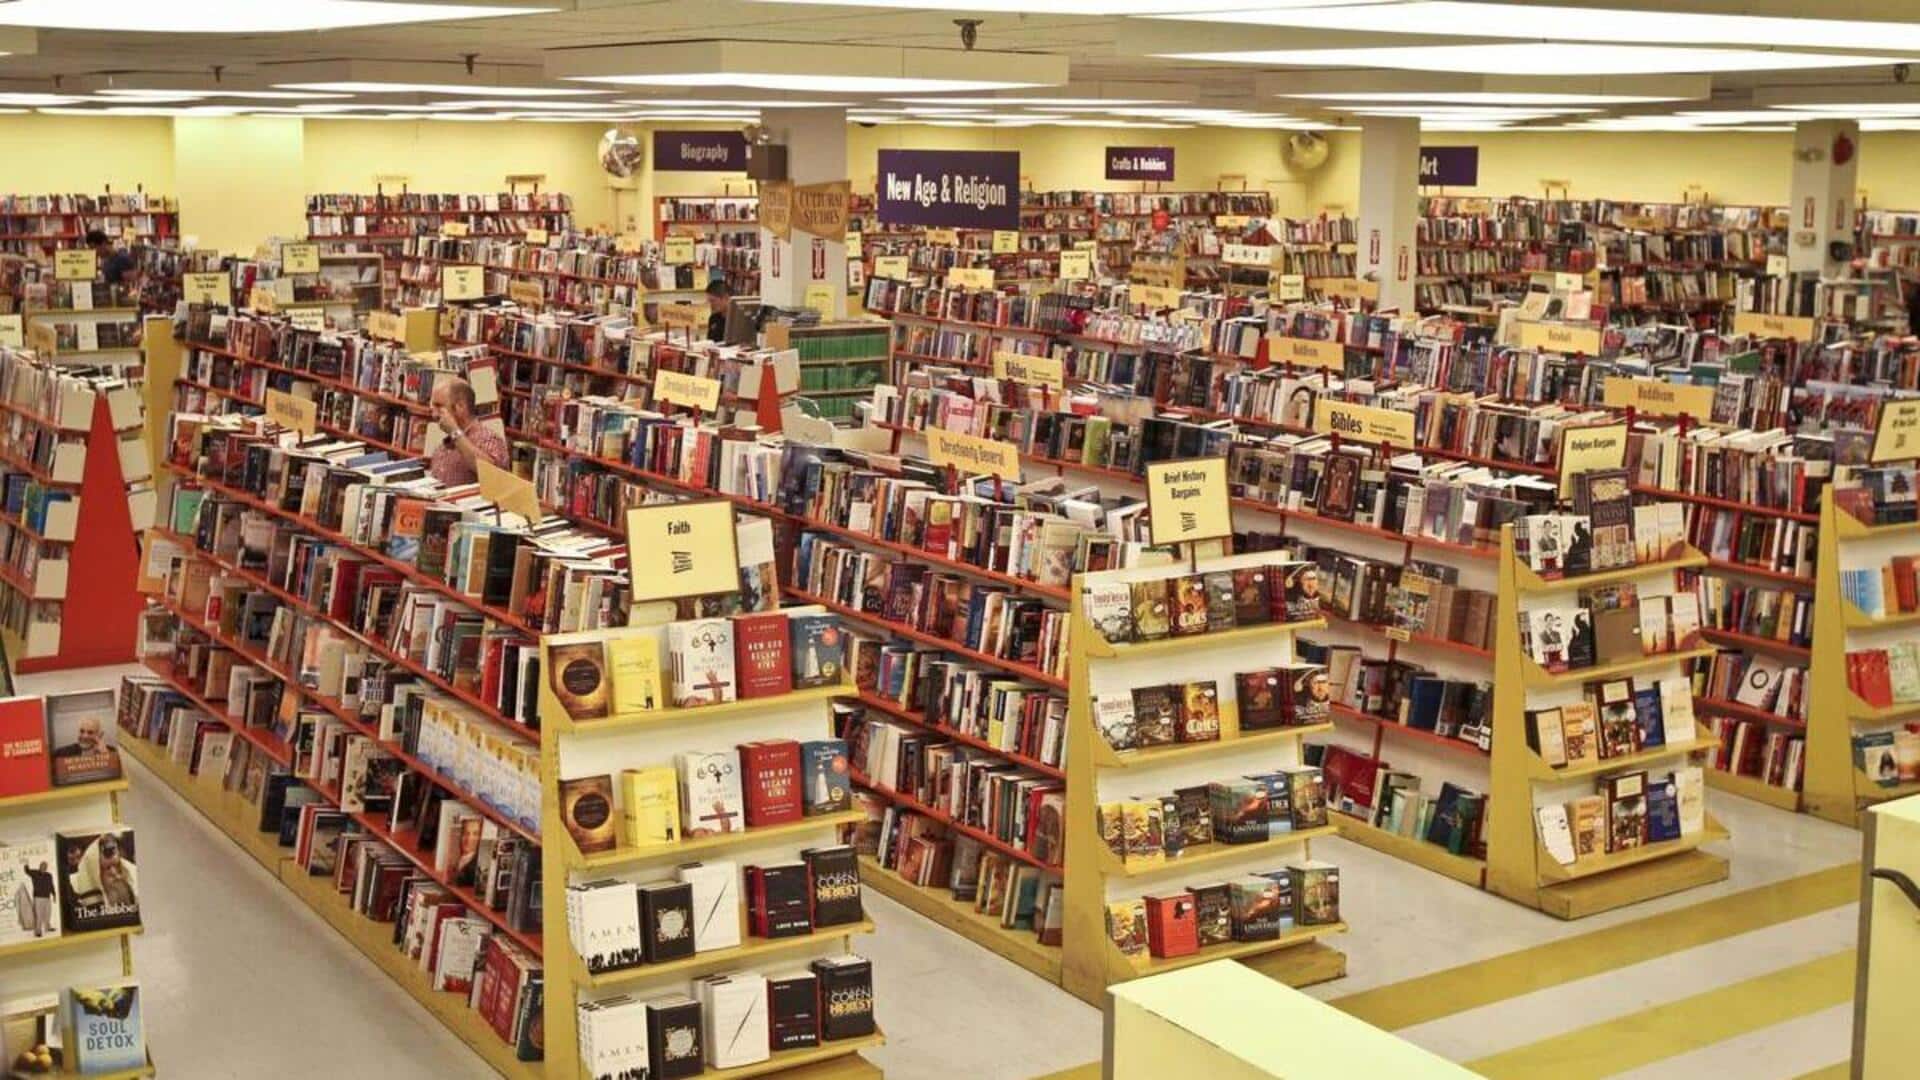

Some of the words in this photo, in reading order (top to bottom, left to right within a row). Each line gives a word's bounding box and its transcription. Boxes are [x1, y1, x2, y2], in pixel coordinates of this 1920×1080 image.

[681, 143, 728, 162] Biography
[1133, 157, 1138, 170] &
[1140, 157, 1166, 170] Hobbies
[1420, 156, 1438, 175] Art
[887, 173, 911, 200] New
[914, 174, 937, 207] Age
[941, 174, 950, 202] &
[955, 175, 1006, 210] Religion
[1006, 360, 1027, 378] Bibles
[1331, 411, 1362, 433] Bibles
[1164, 472, 1181, 484] Brief
[1182, 470, 1206, 482] History
[1171, 487, 1200, 499] Bargains
[668, 520, 690, 535] Faith
[75, 906, 97, 919] The
[590, 925, 635, 938] AMEN
[89, 1022, 127, 1036] SOUL
[87, 1035, 134, 1050] DETOX
[600, 1045, 645, 1058] AMEN
